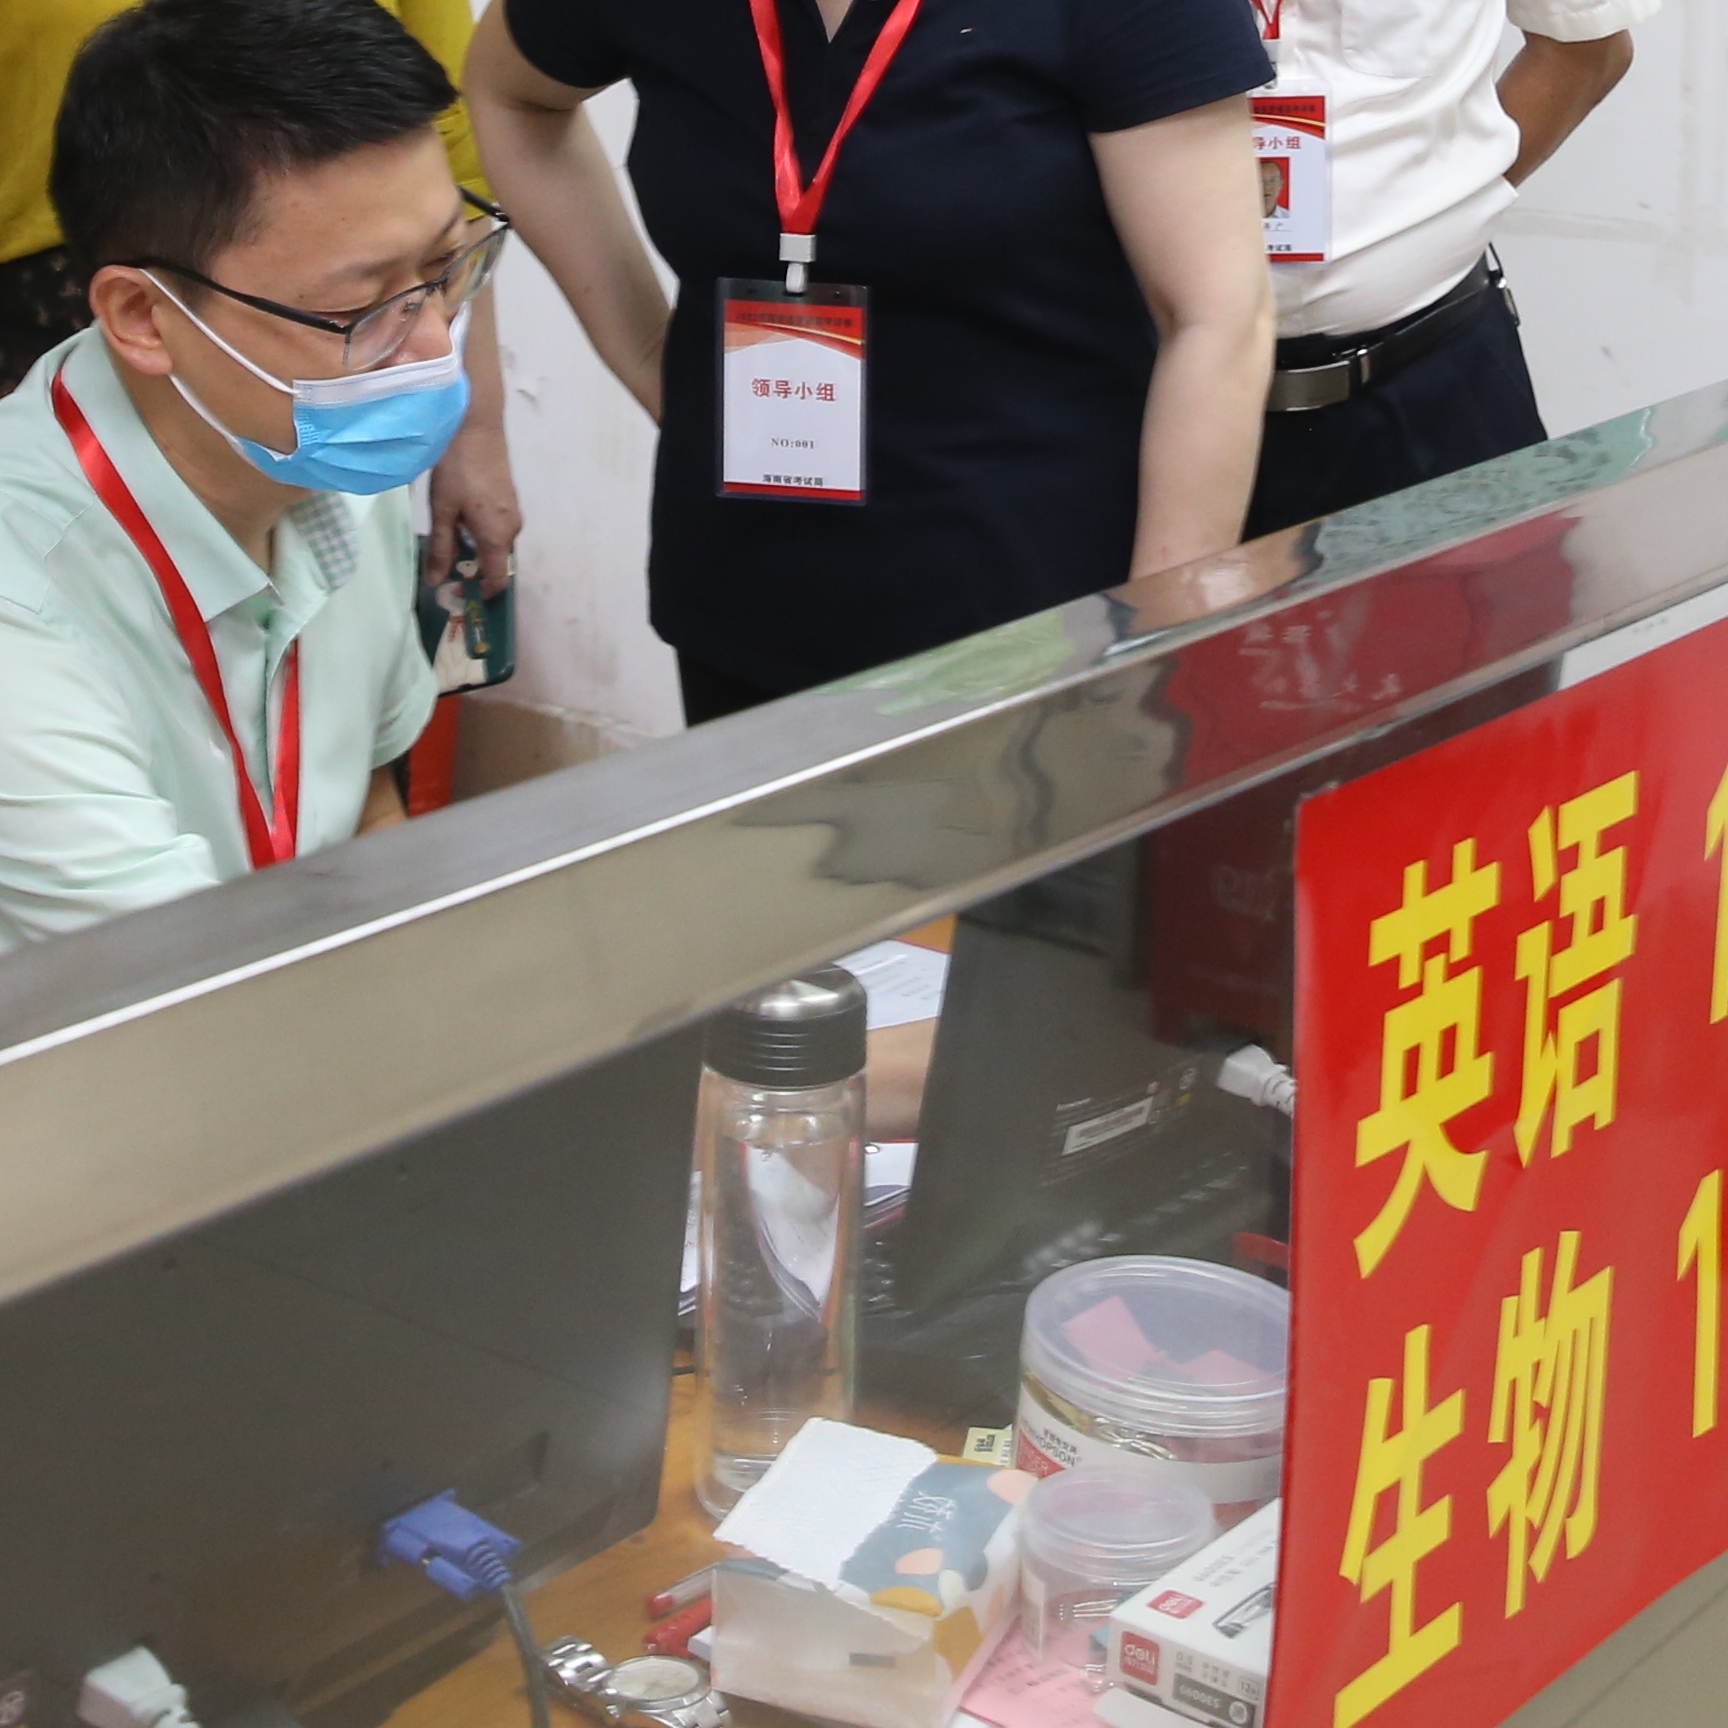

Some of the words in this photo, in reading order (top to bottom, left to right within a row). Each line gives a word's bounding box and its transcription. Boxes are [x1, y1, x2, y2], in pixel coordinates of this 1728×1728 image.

[751, 377, 837, 403] 领导小组
[771, 437, 816, 450] NO:001
[762, 473, 825, 488] 海南省考试局
[1351, 768, 1639, 1280] 英语
[1333, 1226, 1615, 1728] 生物
[1124, 1643, 1156, 1666] deli
